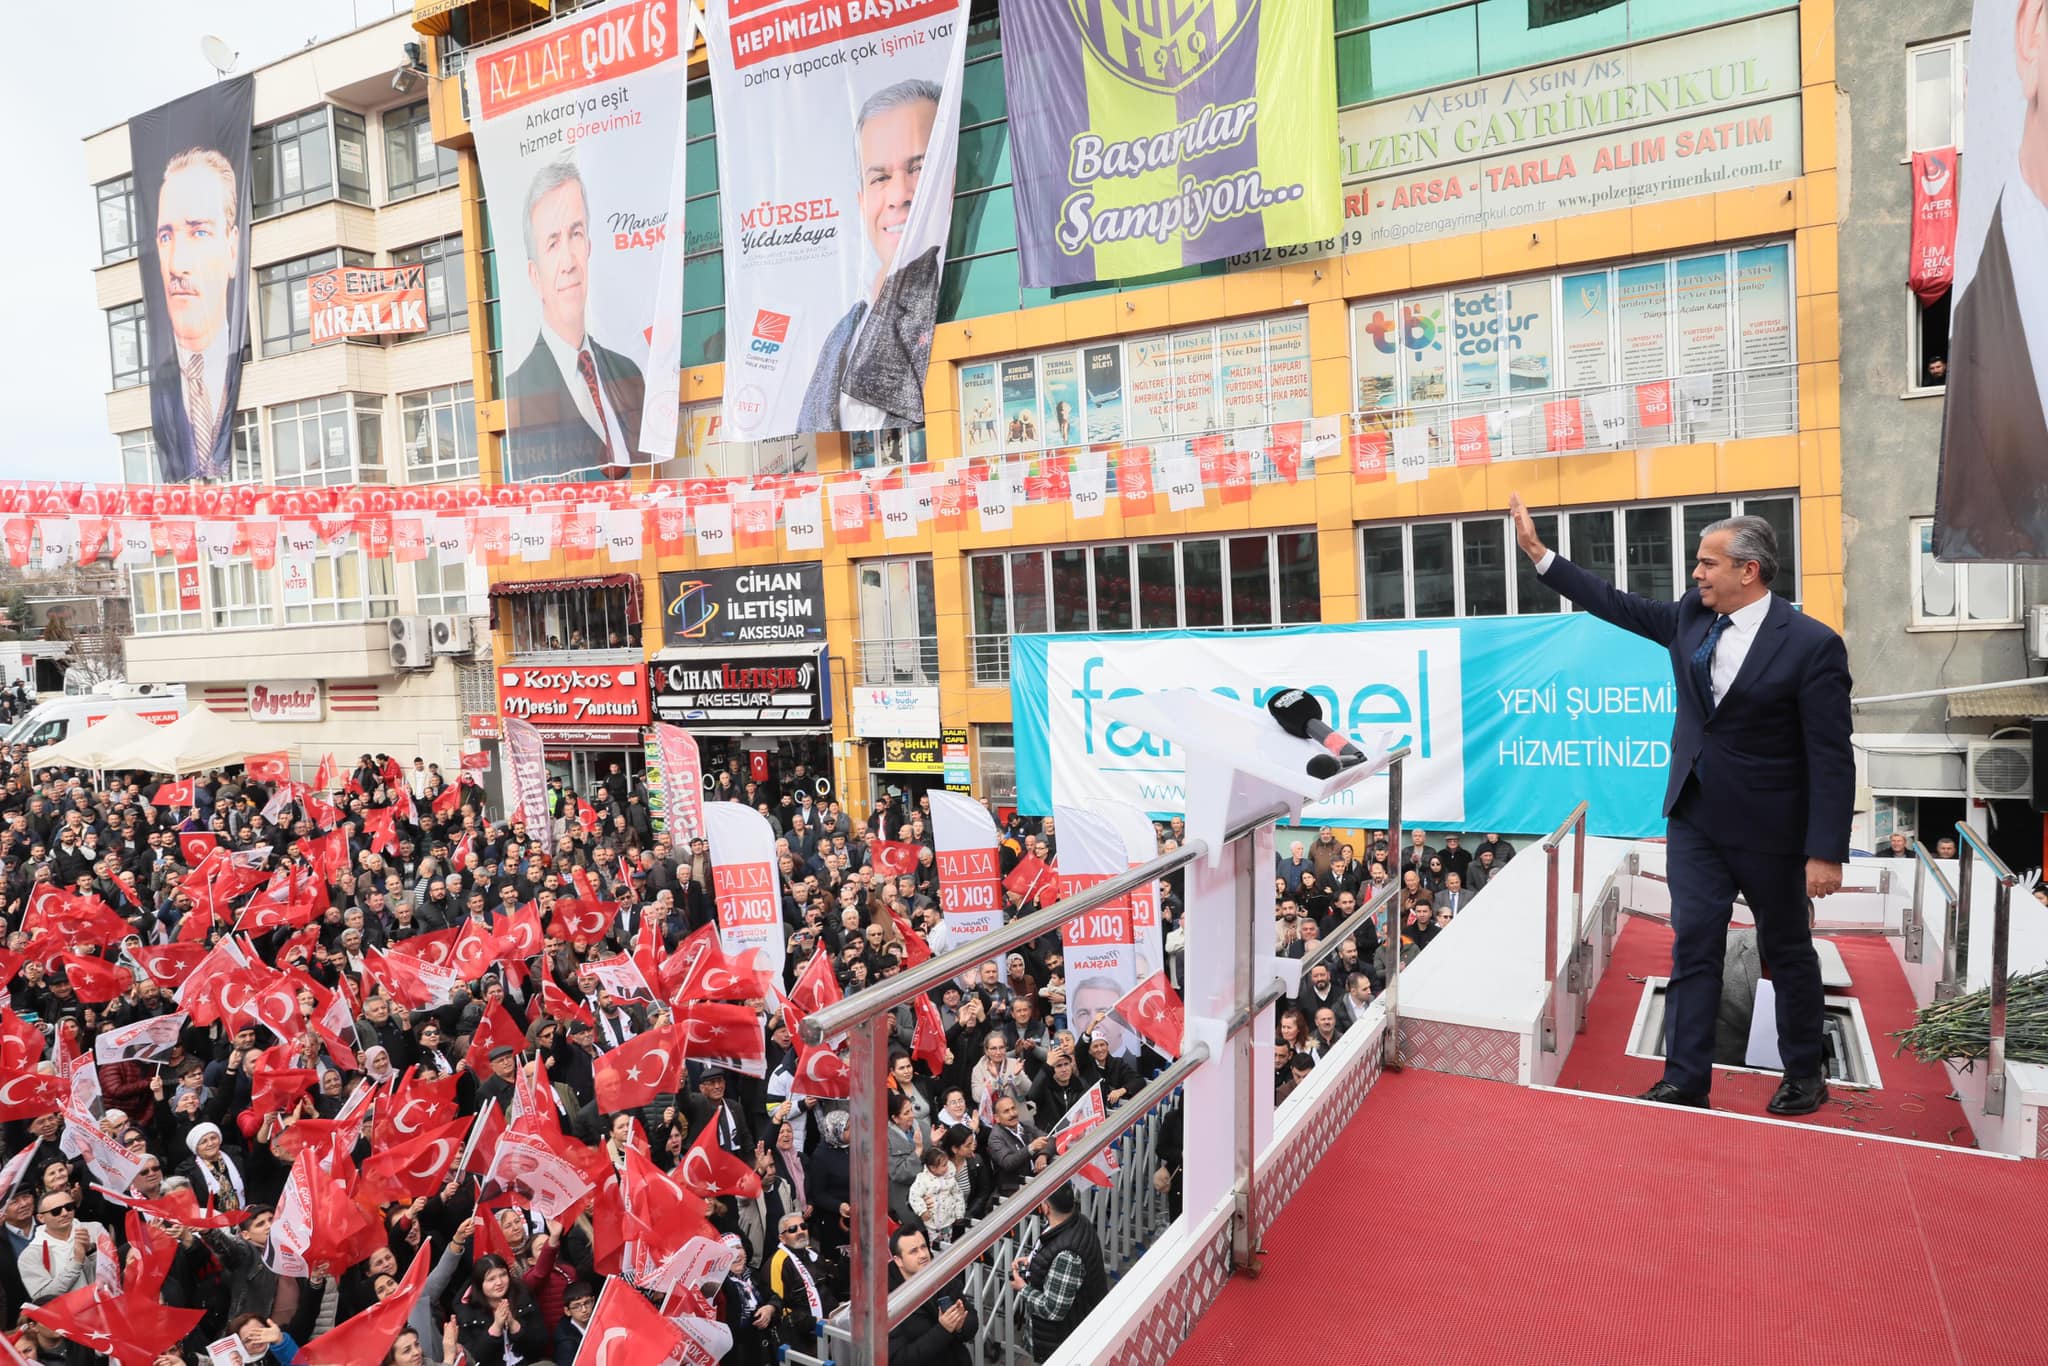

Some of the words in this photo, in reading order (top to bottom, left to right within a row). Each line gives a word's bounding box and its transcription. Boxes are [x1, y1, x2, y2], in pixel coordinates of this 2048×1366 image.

[736, 5, 842, 56] HEPİMİZİN
[490, 56, 520, 104] AZ
[581, 15, 636, 79] ÇOK
[643, 2, 666, 57] İŞ
[744, 68, 780, 87] Daha
[784, 50, 848, 80] yapacak
[850, 41, 878, 65] çok
[881, 29, 925, 57] işimiz
[928, 21, 954, 41] var
[526, 99, 597, 130] Ankara'ya
[601, 87, 630, 111] eşit
[1341, 125, 1440, 176] LZEN
[1454, 55, 1770, 152] GAYRİMENKUL
[1406, 88, 1488, 123] MESUT
[519, 128, 563, 157] hizmet
[566, 110, 641, 144] görevimiz
[1072, 99, 1258, 181] Başarılar
[1392, 175, 1464, 211] ARSA
[1486, 154, 1577, 194] TARLA
[1593, 136, 1666, 174] ALIM
[1674, 115, 1774, 158] SATIM
[607, 210, 669, 235] Mansur
[740, 197, 839, 232] MÜRSEL
[614, 224, 667, 250] BAŞK
[741, 225, 838, 255] Yıldızkaya
[346, 268, 424, 294] EMLAK
[1454, 289, 1513, 317] tatil
[313, 299, 425, 340] KİRALIK
[751, 339, 780, 354] CHP
[736, 571, 802, 593] CİHAN
[728, 597, 812, 623] İLETİŞİM
[738, 624, 806, 641] AKSESUAR
[524, 670, 614, 697] Korykos
[504, 696, 568, 718] Mersin
[572, 698, 638, 721] Tantuni
[696, 692, 771, 707] AKSESUAR
[1497, 682, 1557, 714] YENİ
[1566, 681, 1678, 720] ŞUBEMİ
[904, 739, 938, 750] BALIM
[910, 752, 934, 762] CAFE
[1499, 735, 1670, 768] HİZMETİNİZD
